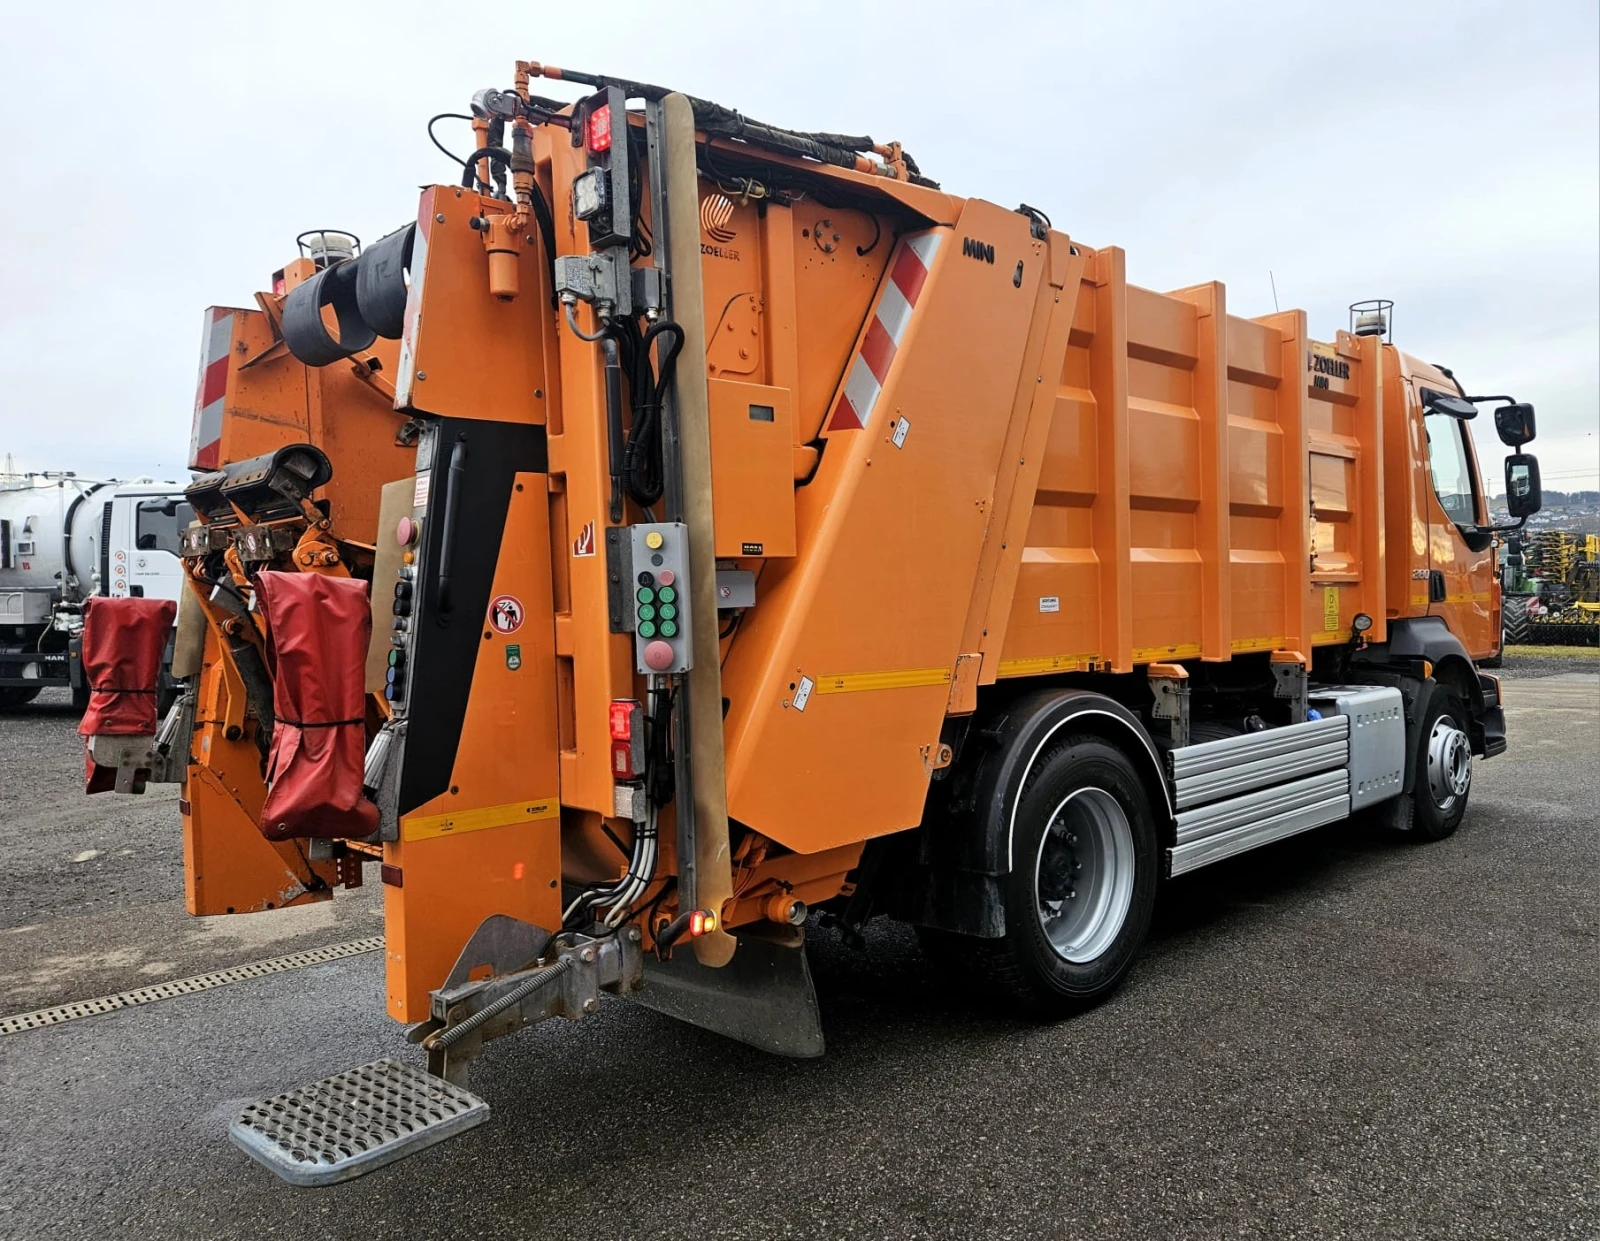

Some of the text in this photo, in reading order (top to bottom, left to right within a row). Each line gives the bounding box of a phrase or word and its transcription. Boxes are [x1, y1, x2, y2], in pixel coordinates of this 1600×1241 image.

[700, 243, 740, 261] ZOELLER
[963, 236, 995, 265] MINI
[1313, 354, 1350, 380] ZOELLER
[1411, 569, 1430, 580] 280
